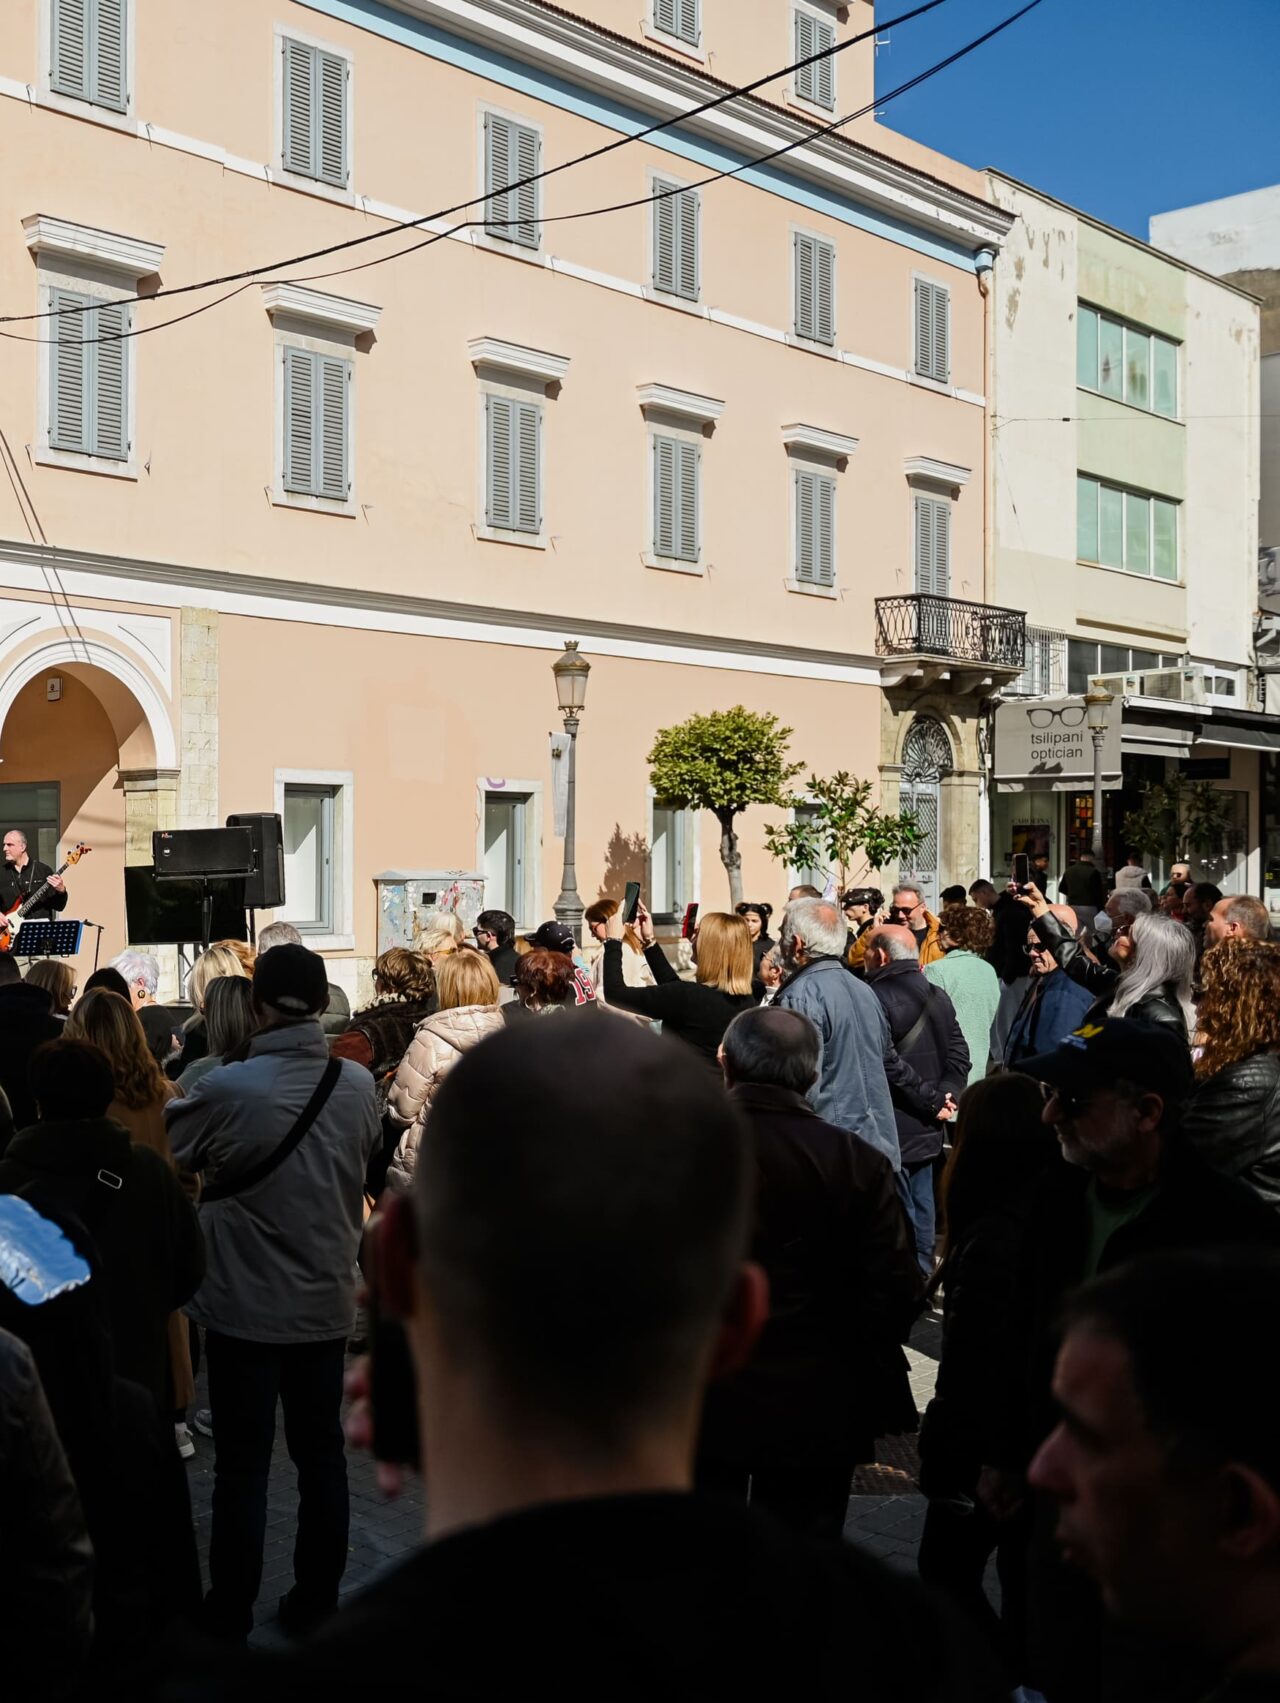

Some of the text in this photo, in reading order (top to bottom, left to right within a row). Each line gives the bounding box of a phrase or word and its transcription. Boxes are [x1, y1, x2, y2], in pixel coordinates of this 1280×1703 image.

[1031, 730, 1083, 746] tsilipani
[1031, 746, 1083, 760] optician
[569, 968, 597, 1006] 19
